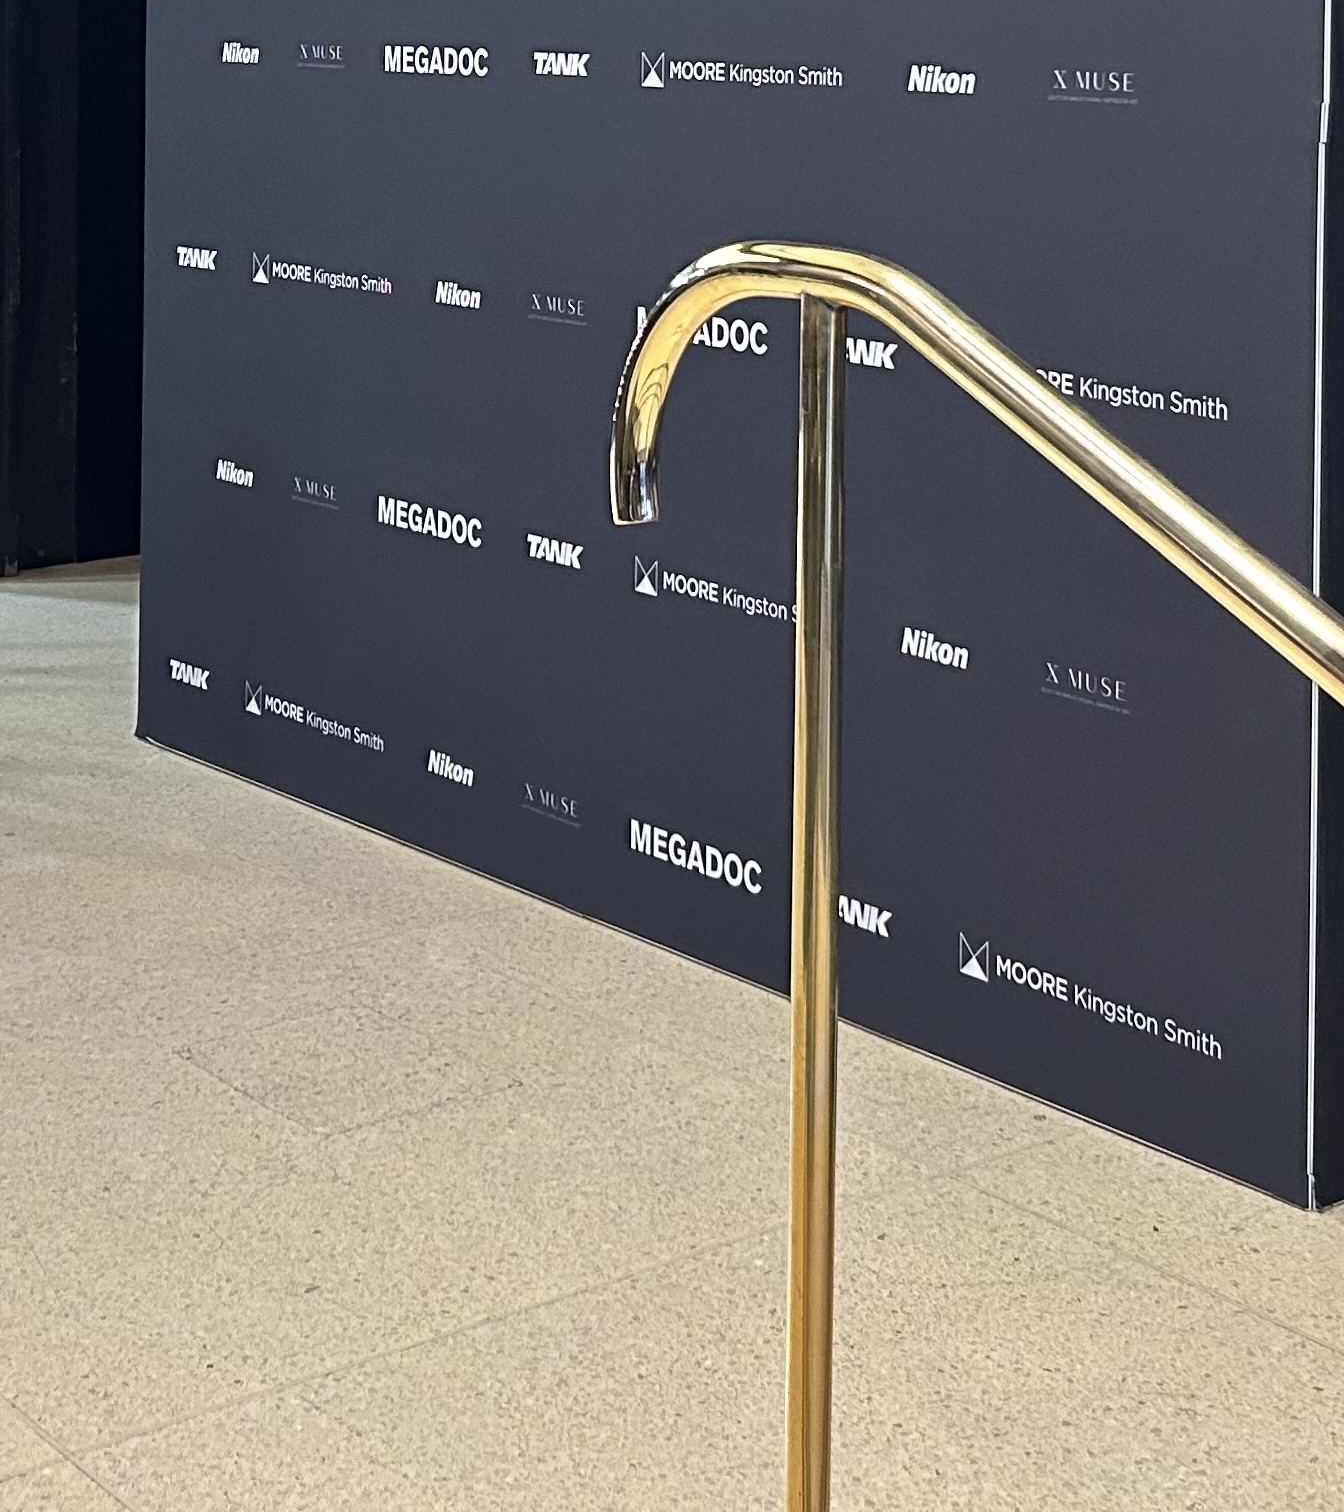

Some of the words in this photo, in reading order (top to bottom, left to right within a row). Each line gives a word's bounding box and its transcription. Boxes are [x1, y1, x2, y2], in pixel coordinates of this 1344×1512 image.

[222, 42, 259, 63] Nikon
[312, 45, 345, 61] MUSE
[385, 45, 488, 76] MEGADOC
[534, 52, 590, 76] TANK
[670, 61, 725, 81] MOORE
[730, 64, 794, 86] Kingston
[799, 66, 842, 86] Smith
[908, 65, 975, 94] Nikon
[1076, 71, 1135, 93] MUSE
[177, 246, 217, 270] TANK
[272, 262, 311, 282] MOORE
[314, 268, 358, 289] Kingston
[361, 275, 391, 294] Smith
[436, 281, 480, 308] Nikon
[545, 294, 585, 317] MUSE
[637, 306, 768, 355] ADOC
[845, 337, 898, 370] ANK
[1080, 377, 1164, 412] Kingston
[1170, 391, 1227, 420] Smith
[216, 460, 253, 487] Nikon
[305, 480, 338, 502] MUSE
[378, 496, 482, 547] MEGADOC
[527, 534, 583, 569] TANK
[663, 571, 718, 602] MOORE
[723, 587, 787, 620] Kingston
[901, 627, 968, 669] Nikon
[170, 659, 209, 690] TANK
[1068, 668, 1127, 702] MUSE
[265, 695, 304, 722] MOORE
[306, 710, 351, 740] Kingston
[354, 727, 384, 752] Smith
[428, 750, 473, 786] Nikon
[539, 788, 579, 818] MUSE
[631, 819, 761, 894] MEGADOC
[838, 895, 892, 938] ANK
[997, 955, 1068, 1001] MOORE
[1075, 985, 1158, 1035] Kingston
[1164, 1019, 1221, 1059] Smith
